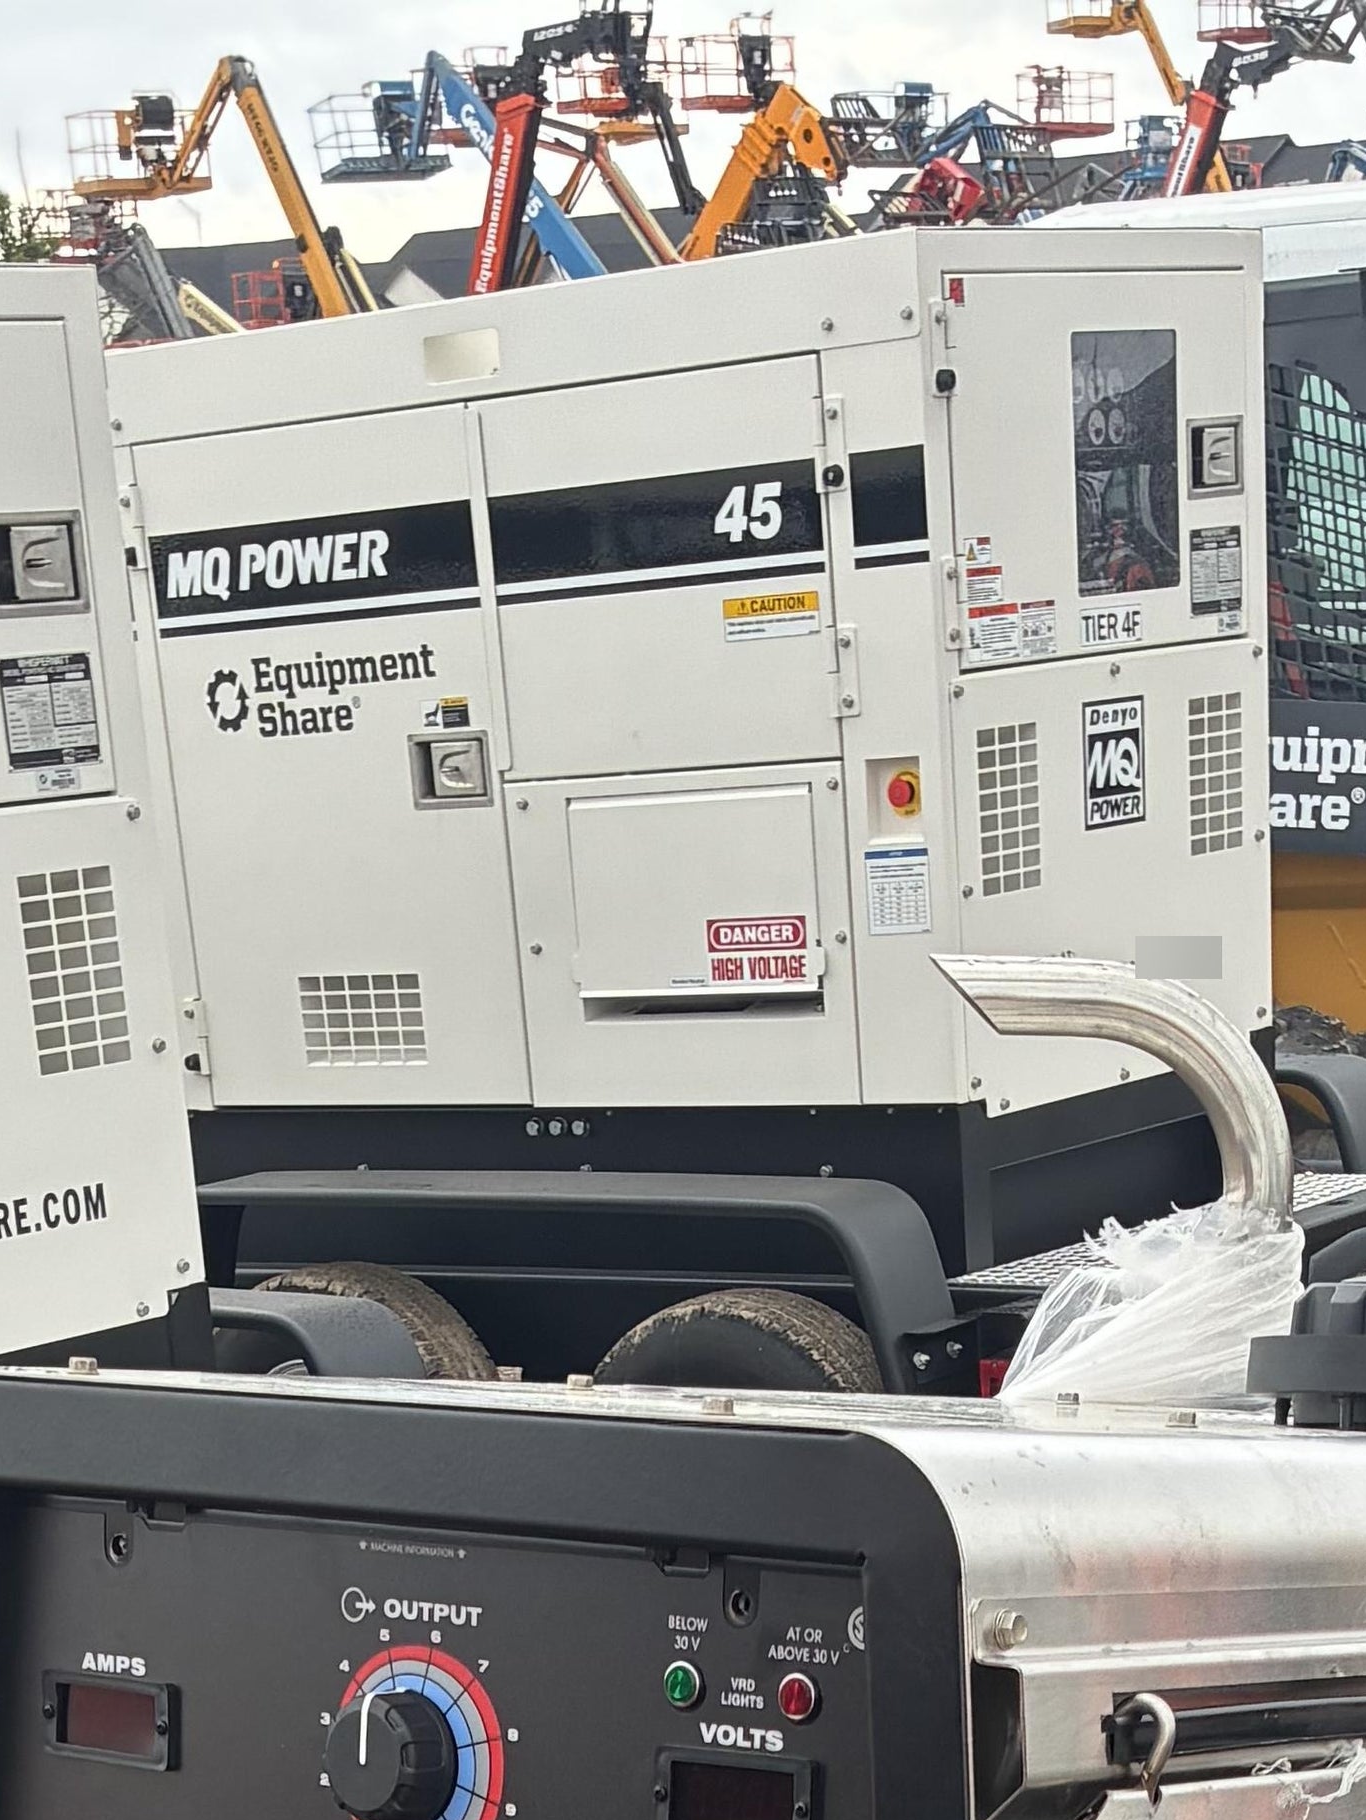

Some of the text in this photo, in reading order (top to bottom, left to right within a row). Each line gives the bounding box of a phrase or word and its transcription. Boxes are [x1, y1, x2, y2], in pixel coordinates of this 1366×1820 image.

[713, 481, 782, 542] 45
[167, 529, 390, 601] MQ POWER
[749, 595, 806, 613] CAUTION
[1082, 611, 1141, 644] TIER 4F
[251, 643, 437, 697] Equipment
[1090, 707, 1138, 727] Denyo
[1088, 737, 1142, 791] MQ
[1091, 795, 1141, 822] POWER
[719, 925, 794, 944] DANGER
[711, 955, 806, 981] HIGH VOLTAGE
[403, 1544, 454, 1558] INFORMATION
[384, 1598, 482, 1627] OUTPUT
[668, 1614, 709, 1633] BELOW
[379, 1628, 390, 1642] 5
[430, 1630, 442, 1644] 6
[674, 1635, 701, 1651] 30 V
[786, 1626, 822, 1644] AT OR
[768, 1644, 840, 1666] ABOVE 30 V
[81, 1652, 147, 1678] AMPS
[339, 1659, 350, 1672] 4
[478, 1659, 490, 1673] 7
[731, 1676, 756, 1693] VRD
[721, 1691, 764, 1710] LIGHTS
[320, 1712, 331, 1725] 3
[508, 1728, 519, 1742] 8
[699, 1722, 784, 1752] VOLTS
[320, 1773, 331, 1787] 2
